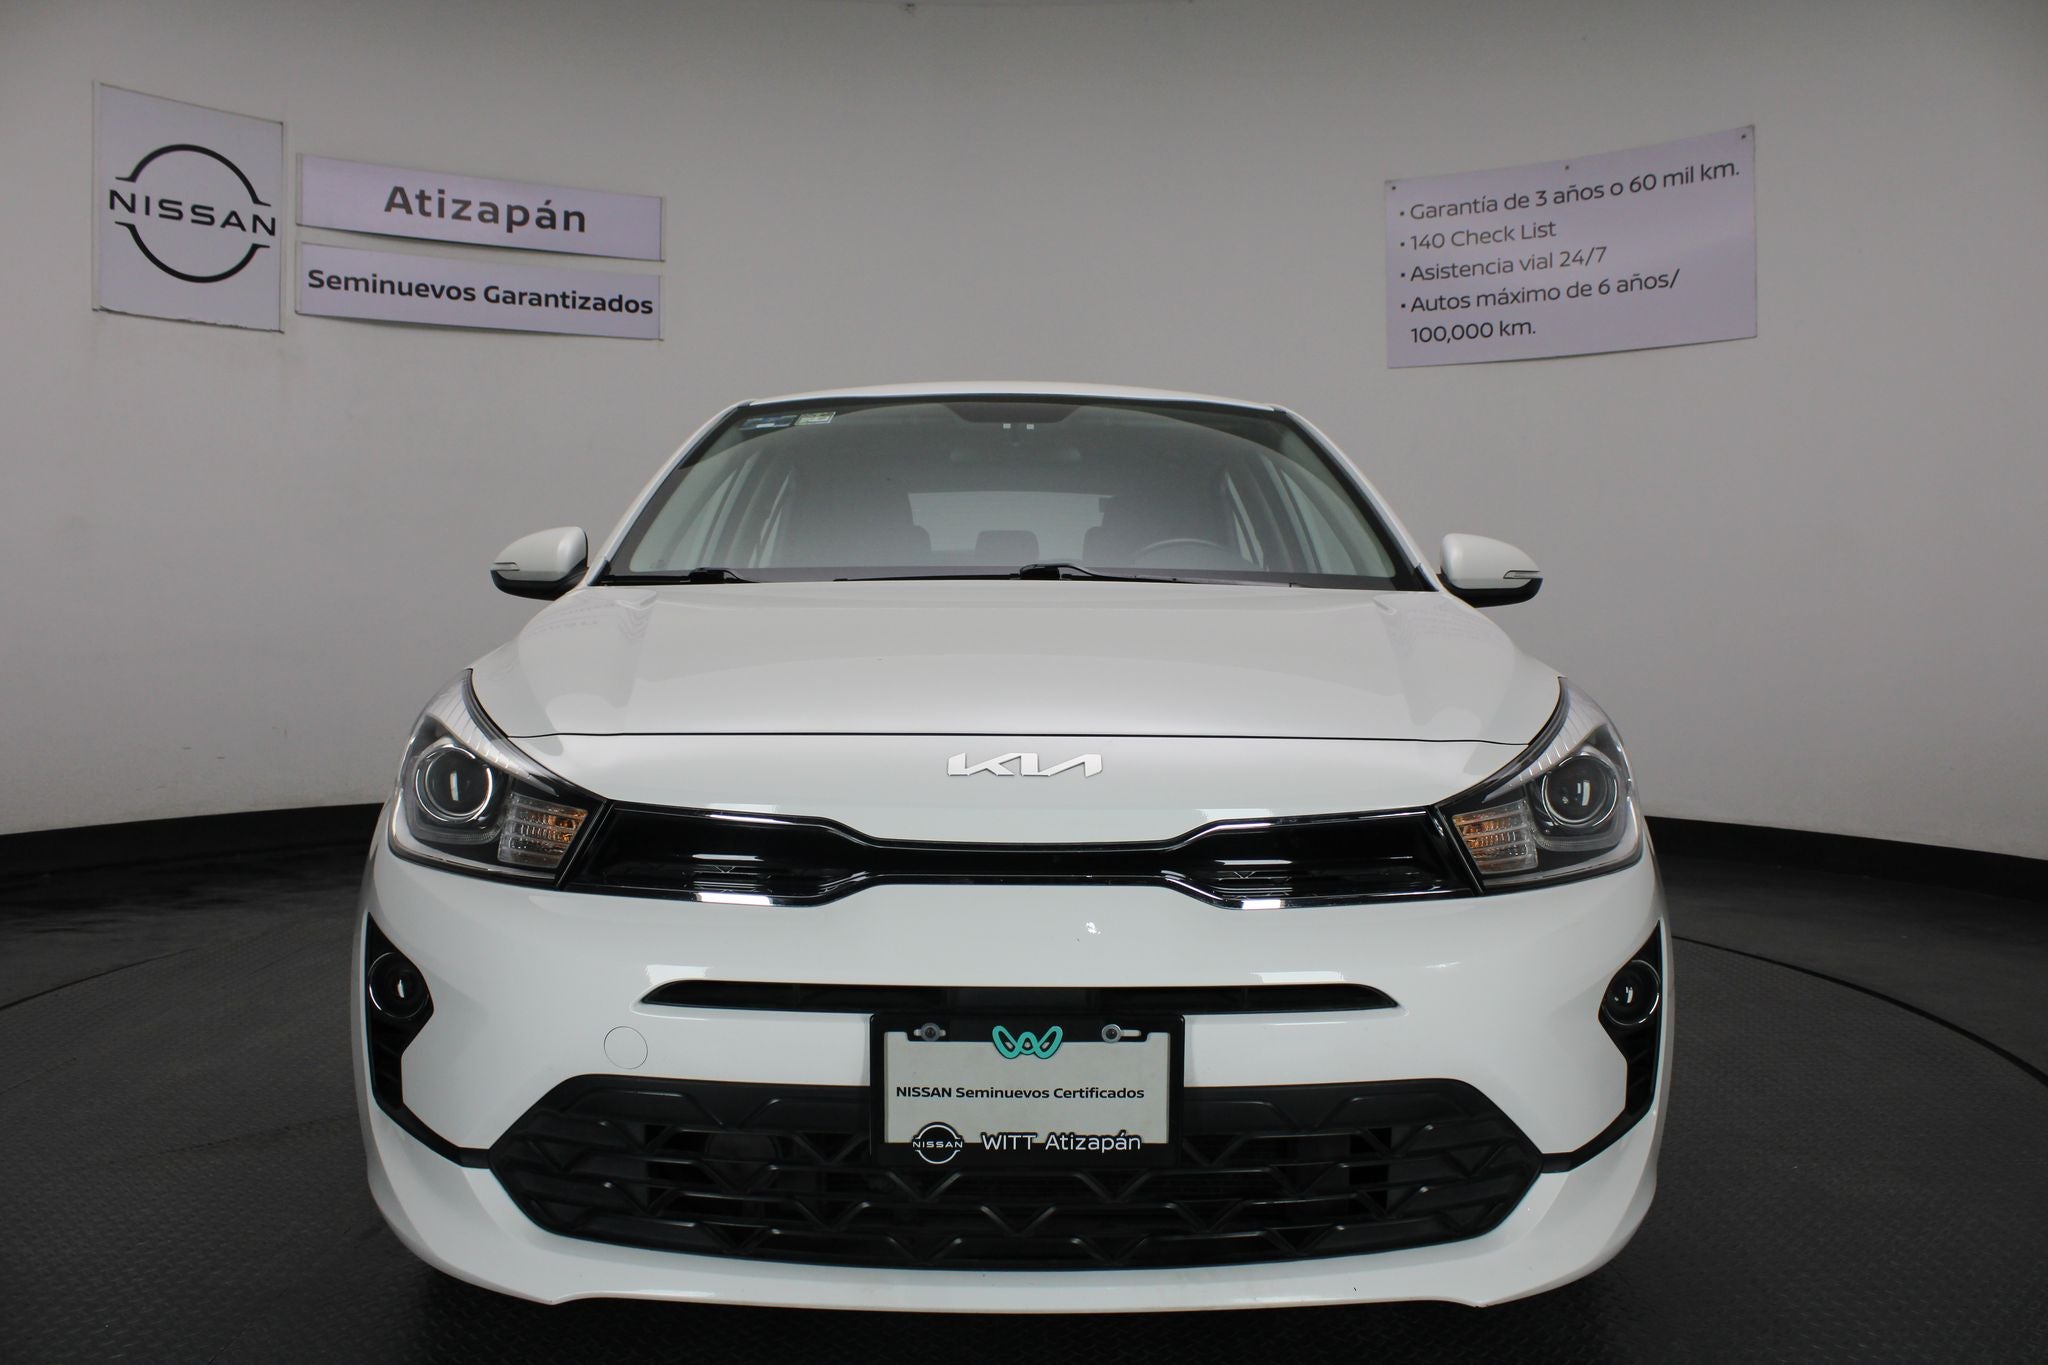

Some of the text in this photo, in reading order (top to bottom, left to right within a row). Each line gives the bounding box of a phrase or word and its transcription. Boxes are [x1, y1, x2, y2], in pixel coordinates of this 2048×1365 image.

[384, 185, 587, 234] Atizapán
[1410, 160, 1740, 220] Garantía de 3 años o 60 mil km.
[108, 189, 276, 236] NISSAN
[1411, 221, 1557, 251] 140 Check List
[1410, 246, 1607, 282] Asistencia vial 24/7
[308, 268, 654, 315] Seminuevos Garantizados
[1410, 268, 1680, 312] Autos máximo de 6 años/
[1411, 320, 1536, 345] 100,000 km.
[947, 752, 1102, 777] KIA
[896, 1086, 1145, 1100] NISSAN Seminuevos Certificados
